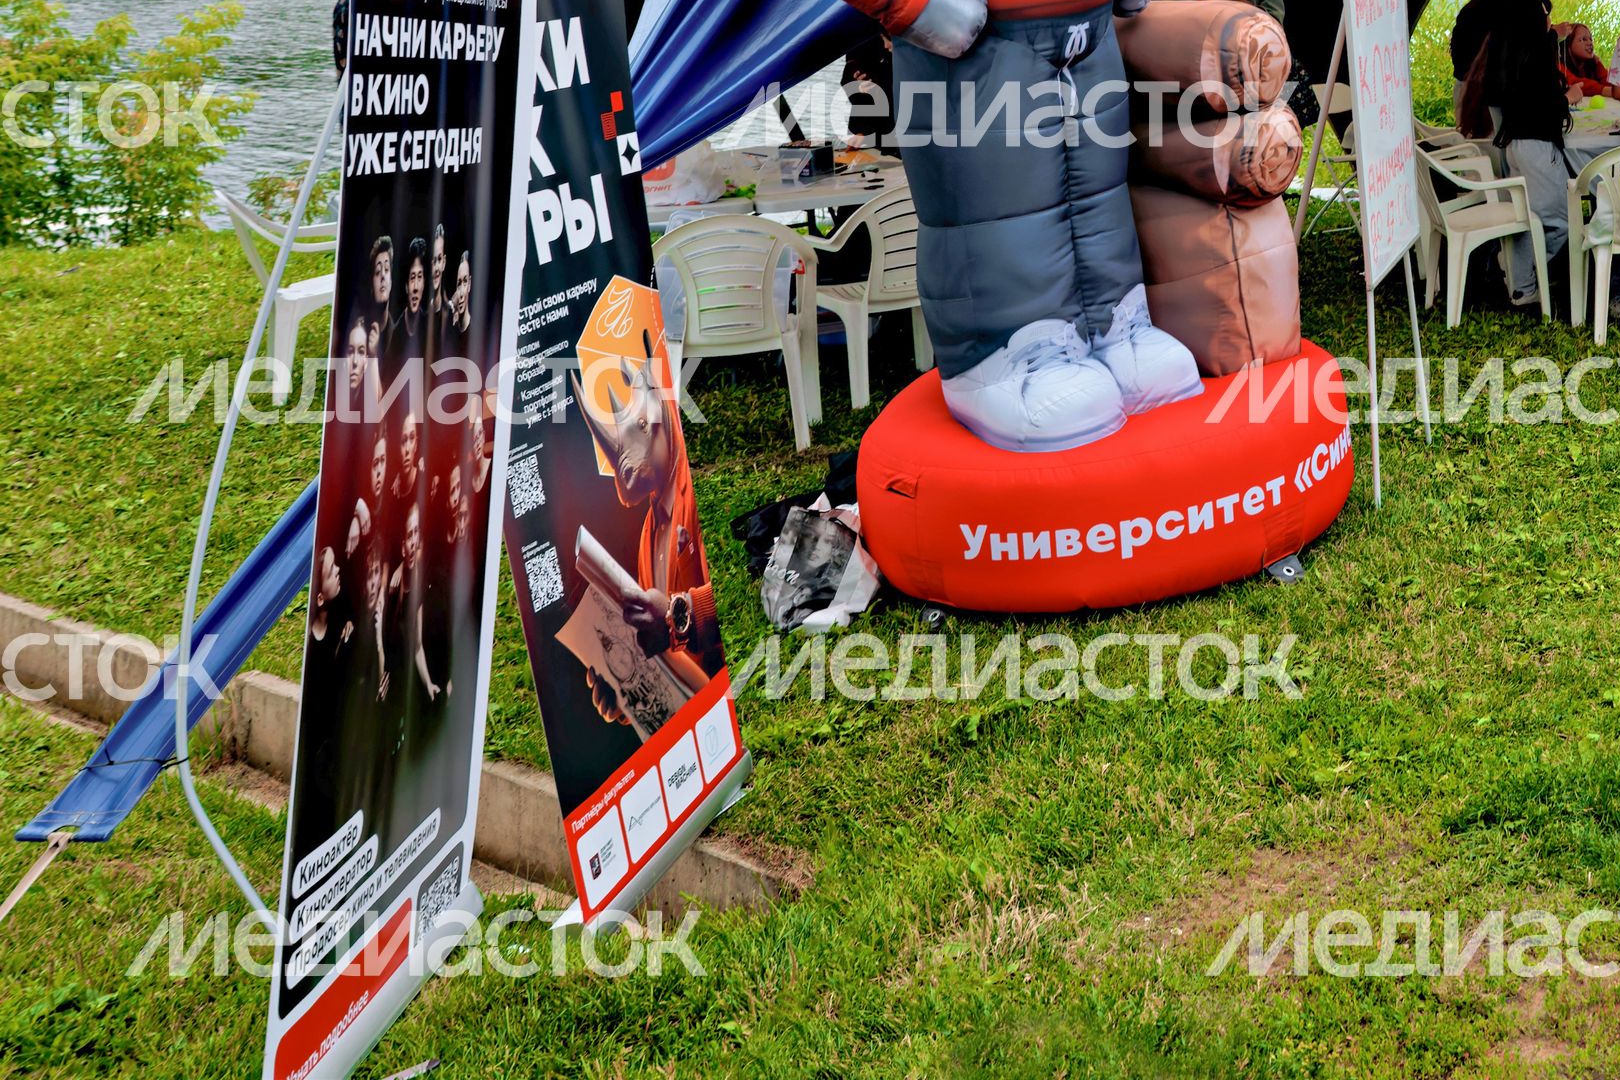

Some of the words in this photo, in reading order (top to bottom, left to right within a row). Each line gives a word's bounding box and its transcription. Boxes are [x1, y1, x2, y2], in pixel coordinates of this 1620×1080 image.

[354, 13, 427, 59] НАЧНИ
[430, 20, 505, 62] КАРЬЕРУ
[351, 73, 363, 116] В
[366, 73, 429, 116] КИНО
[347, 131, 398, 177] УЖЕ
[400, 127, 483, 174] СЕГОДНЯ
[542, 290, 565, 309] свою
[566, 277, 598, 300] карьеру
[546, 305, 569, 323] нами
[959, 475, 1286, 561] Университет
[667, 763, 686, 788] DESIGN
[675, 762, 697, 790] MACHINE
[298, 823, 358, 889] Киноактёр
[294, 910, 350, 976] Продюсер
[351, 886, 375, 916] кино
[384, 818, 437, 886] телевидения
[296, 848, 373, 933] Кинооператор
